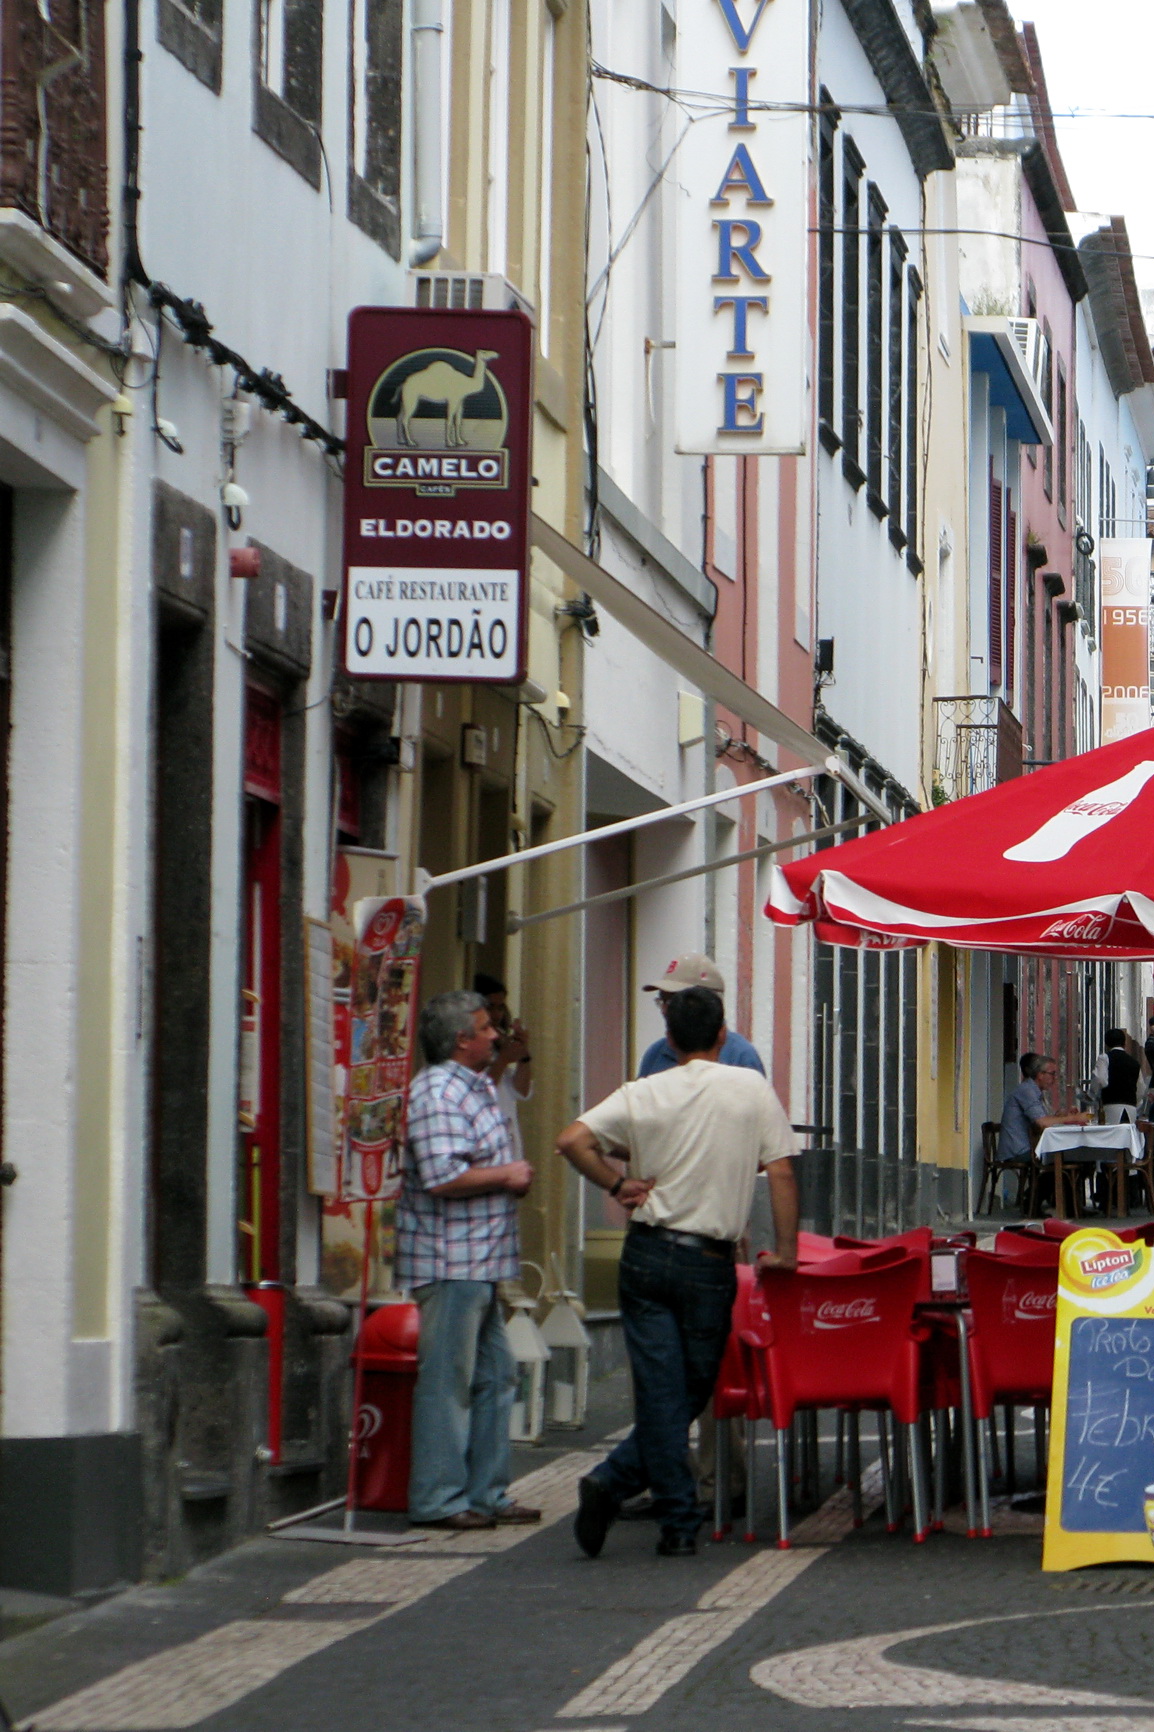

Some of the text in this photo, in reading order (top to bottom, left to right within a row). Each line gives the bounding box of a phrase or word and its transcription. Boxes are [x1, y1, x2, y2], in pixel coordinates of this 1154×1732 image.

[372, 457, 499, 479] CAMELO
[359, 518, 512, 540] ELDORADO
[354, 574, 509, 602] CAFÉ RESTAURANTE
[1103, 609, 1149, 626] 1956
[354, 608, 508, 660] O JORDÃO
[1102, 685, 1150, 699] 2006
[1083, 1254, 1129, 1273] Lipton
[816, 1297, 878, 1320] Coca-Cola
